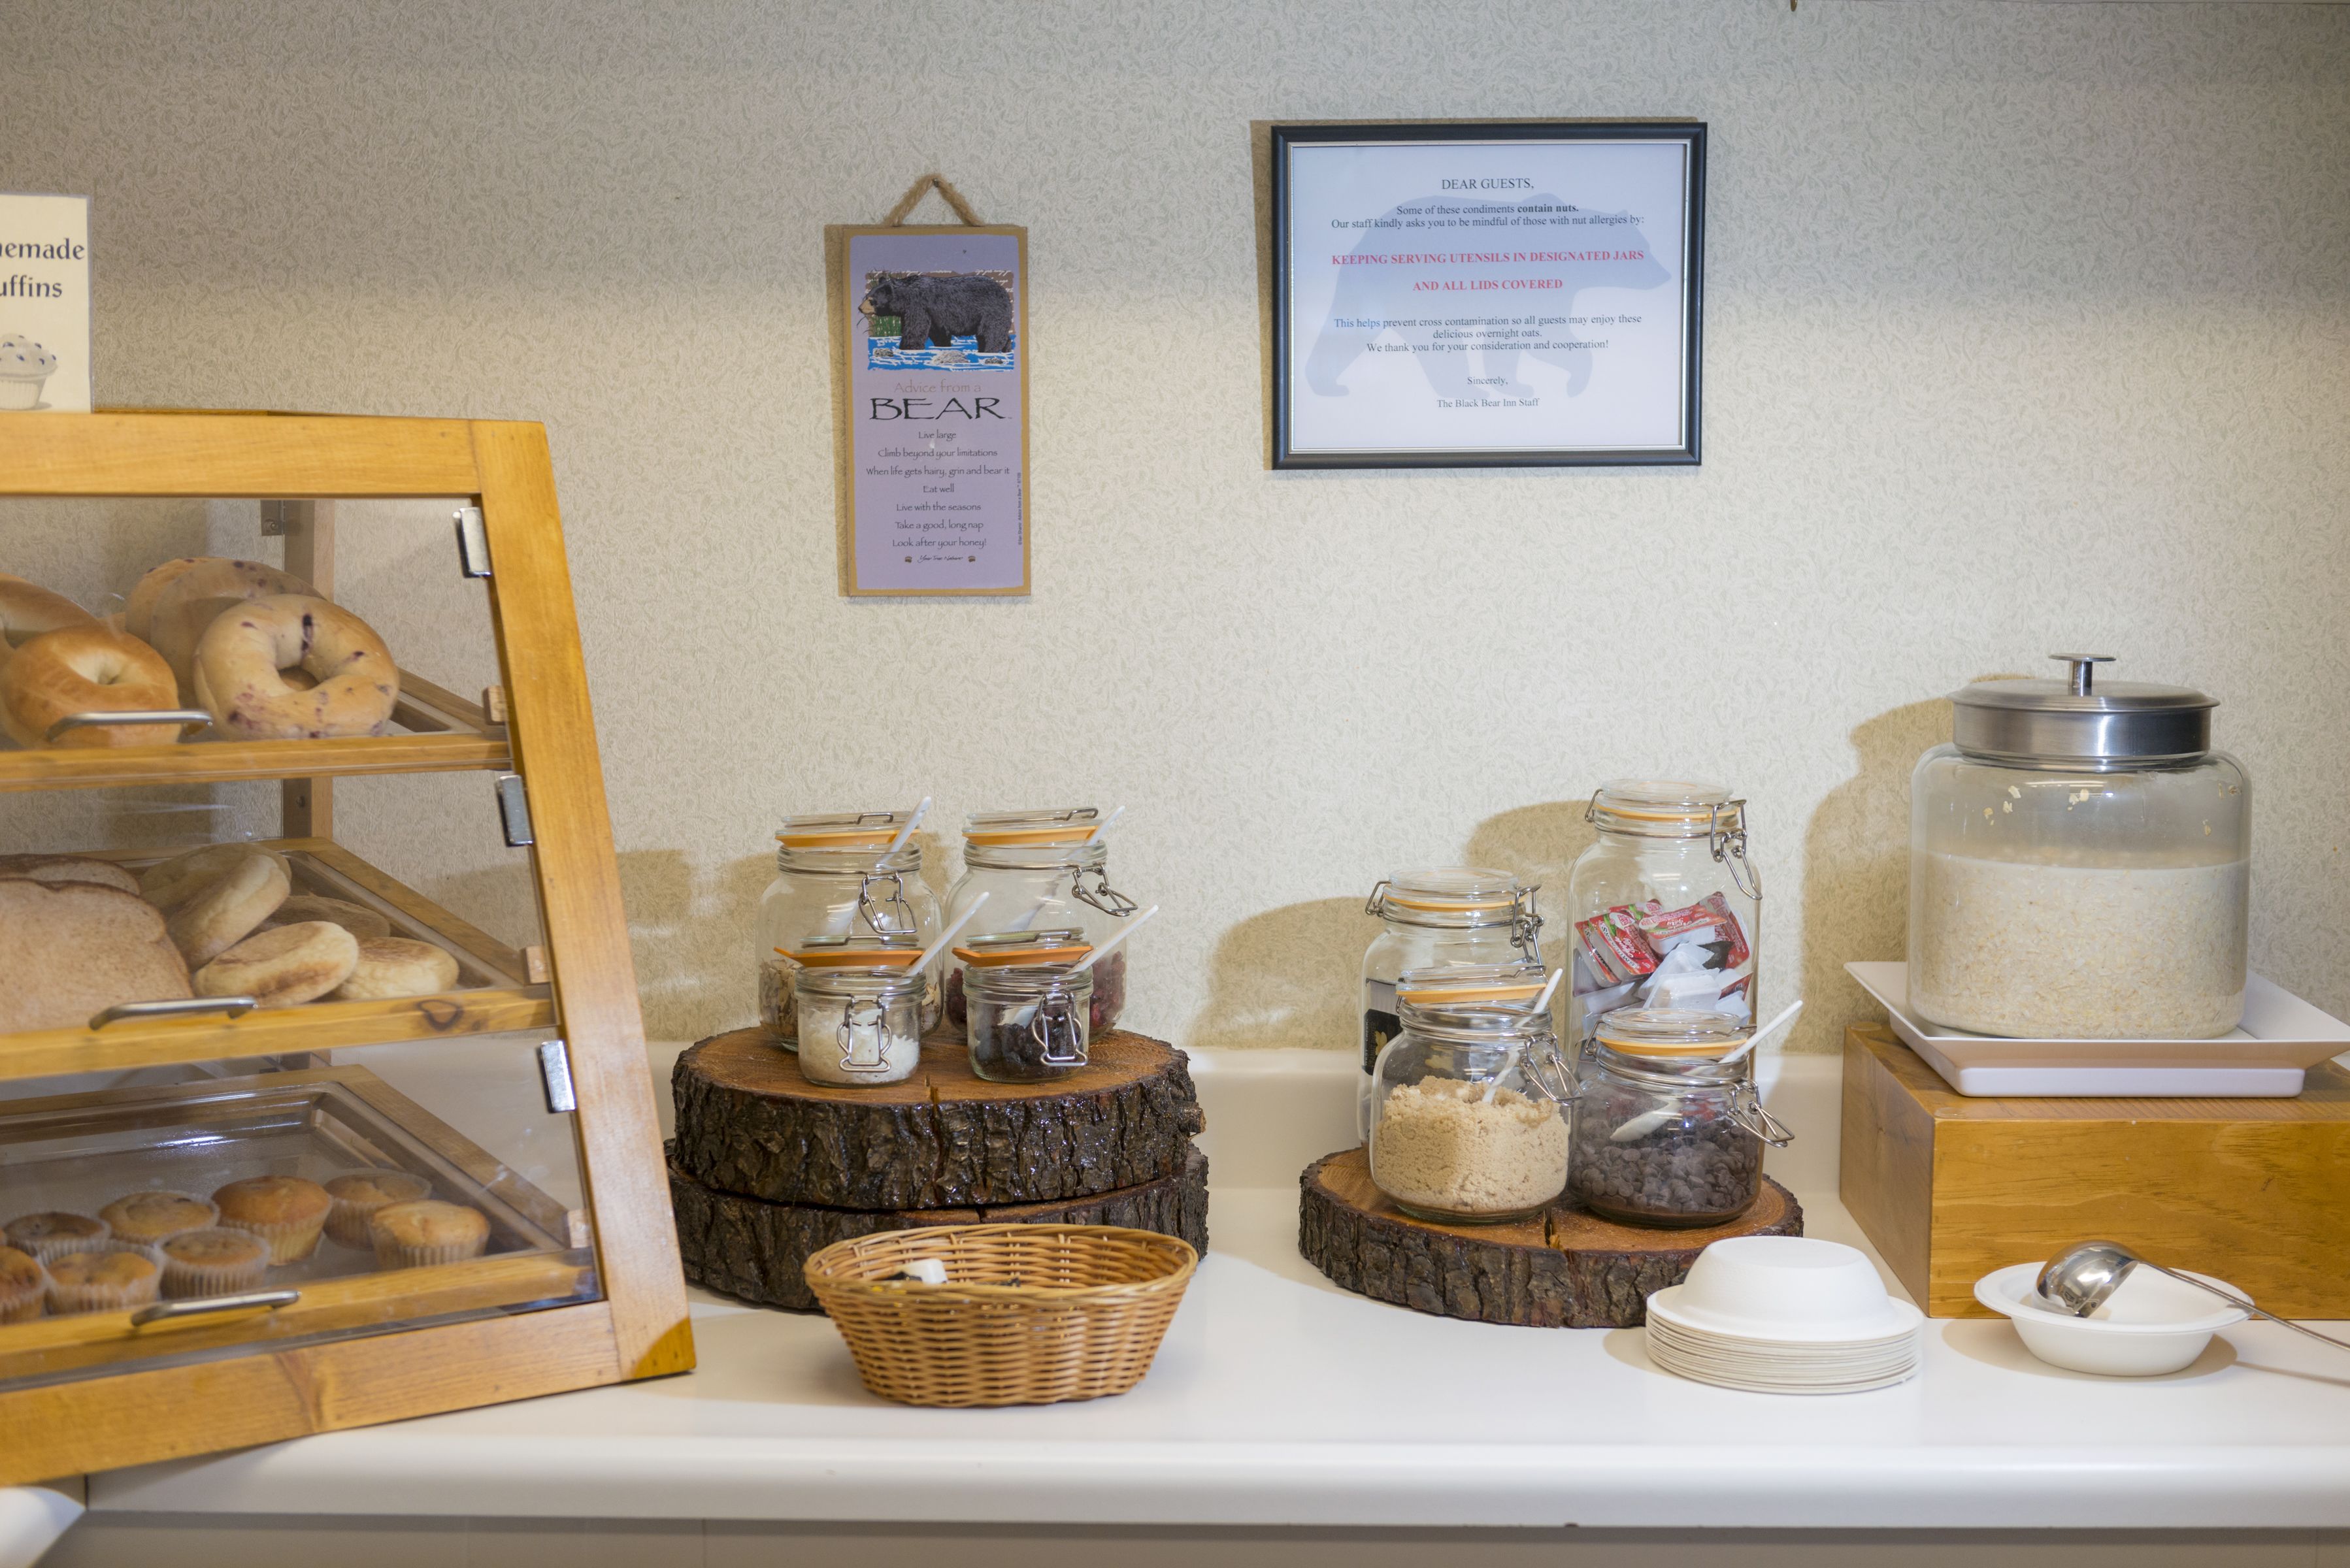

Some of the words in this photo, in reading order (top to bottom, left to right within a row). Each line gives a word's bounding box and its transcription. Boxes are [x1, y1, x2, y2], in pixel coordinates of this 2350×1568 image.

[1441, 178, 1478, 190] DEAR
[1480, 178, 1534, 190] GUESTS,
[1396, 205, 1423, 216] Some
[1425, 204, 1436, 215] of
[1436, 204, 1461, 214] these
[1462, 204, 1515, 216] condiments
[1517, 203, 1553, 214] contain
[1555, 203, 1580, 213] nuts.
[1331, 219, 1349, 229] Our
[1351, 218, 1374, 229] staff
[1374, 218, 1404, 230] kindly
[1405, 218, 1426, 228] asks
[1427, 220, 1446, 229] you
[1458, 217, 1470, 227] be
[1472, 216, 1508, 227] mindful
[1510, 216, 1522, 226] of
[1522, 216, 1547, 225] those
[1549, 215, 1570, 225] with
[1571, 216, 1587, 225] nut
[1589, 214, 1628, 227] allergies
[1629, 214, 1644, 226] by:
[0, 238, 85, 260] emade
[1331, 254, 1388, 265] KEEPING
[1390, 253, 1446, 265] SERVING
[1449, 252, 1510, 264] UTENSILS
[1513, 252, 1527, 262] IN
[1529, 250, 1611, 262] DESIGNATED
[1612, 250, 1644, 261] JARS
[1412, 281, 1440, 291] AND
[1442, 280, 1468, 291] ALL
[1470, 280, 1499, 291] LIDS
[1501, 279, 1563, 290] COVERED
[1334, 318, 1355, 328] This
[1356, 318, 1381, 330] helps
[1383, 319, 1417, 329] prevent
[1444, 316, 1509, 327] contamination
[1524, 315, 1536, 325] all
[1538, 316, 1567, 327] guests
[1568, 317, 1588, 326] may
[1591, 314, 1615, 325] enjoy
[1618, 314, 1642, 323] these
[1432, 329, 1474, 339] delicious
[1476, 328, 1519, 342] overnight
[1521, 329, 1542, 338] oats.
[1366, 343, 1383, 352] We
[1384, 342, 1410, 352] thank
[1412, 344, 1429, 353] you
[1432, 342, 1446, 351] for
[1447, 344, 1469, 353] your
[1470, 340, 1531, 350] consideration
[1533, 340, 1550, 350] and
[1552, 339, 1608, 351] cooperation!
[894, 379, 936, 393] Advice
[940, 378, 970, 393] from
[974, 384, 982, 393] a
[1467, 376, 1508, 386] Sincerely,
[1436, 399, 1453, 408] The
[1455, 399, 1479, 408] Black
[1481, 399, 1501, 407] Bear
[1503, 398, 1517, 407] Inn
[1519, 397, 1540, 406] Staff
[918, 431, 935, 439] Live
[935, 429, 957, 442] large
[878, 446, 902, 457] Climb
[902, 447, 935, 461] beyond
[935, 450, 956, 461] your
[957, 446, 998, 457] limitations
[866, 465, 889, 476] When
[890, 465, 903, 476] life
[904, 468, 923, 479] gets
[923, 465, 947, 479] hairy,
[948, 466, 965, 478] grin
[966, 465, 982, 475] and
[984, 465, 1003, 475] bear
[938, 483, 955, 493] well
[896, 503, 913, 512] Live
[914, 501, 931, 512] with
[932, 500, 946, 511] the
[895, 519, 914, 529] Take
[922, 518, 947, 532] good,
[948, 518, 968, 532] long
[968, 523, 984, 533] nap
[892, 536, 914, 547] Look
[915, 536, 936, 547] after
[937, 538, 958, 550] your
[958, 536, 987, 549] honey!
